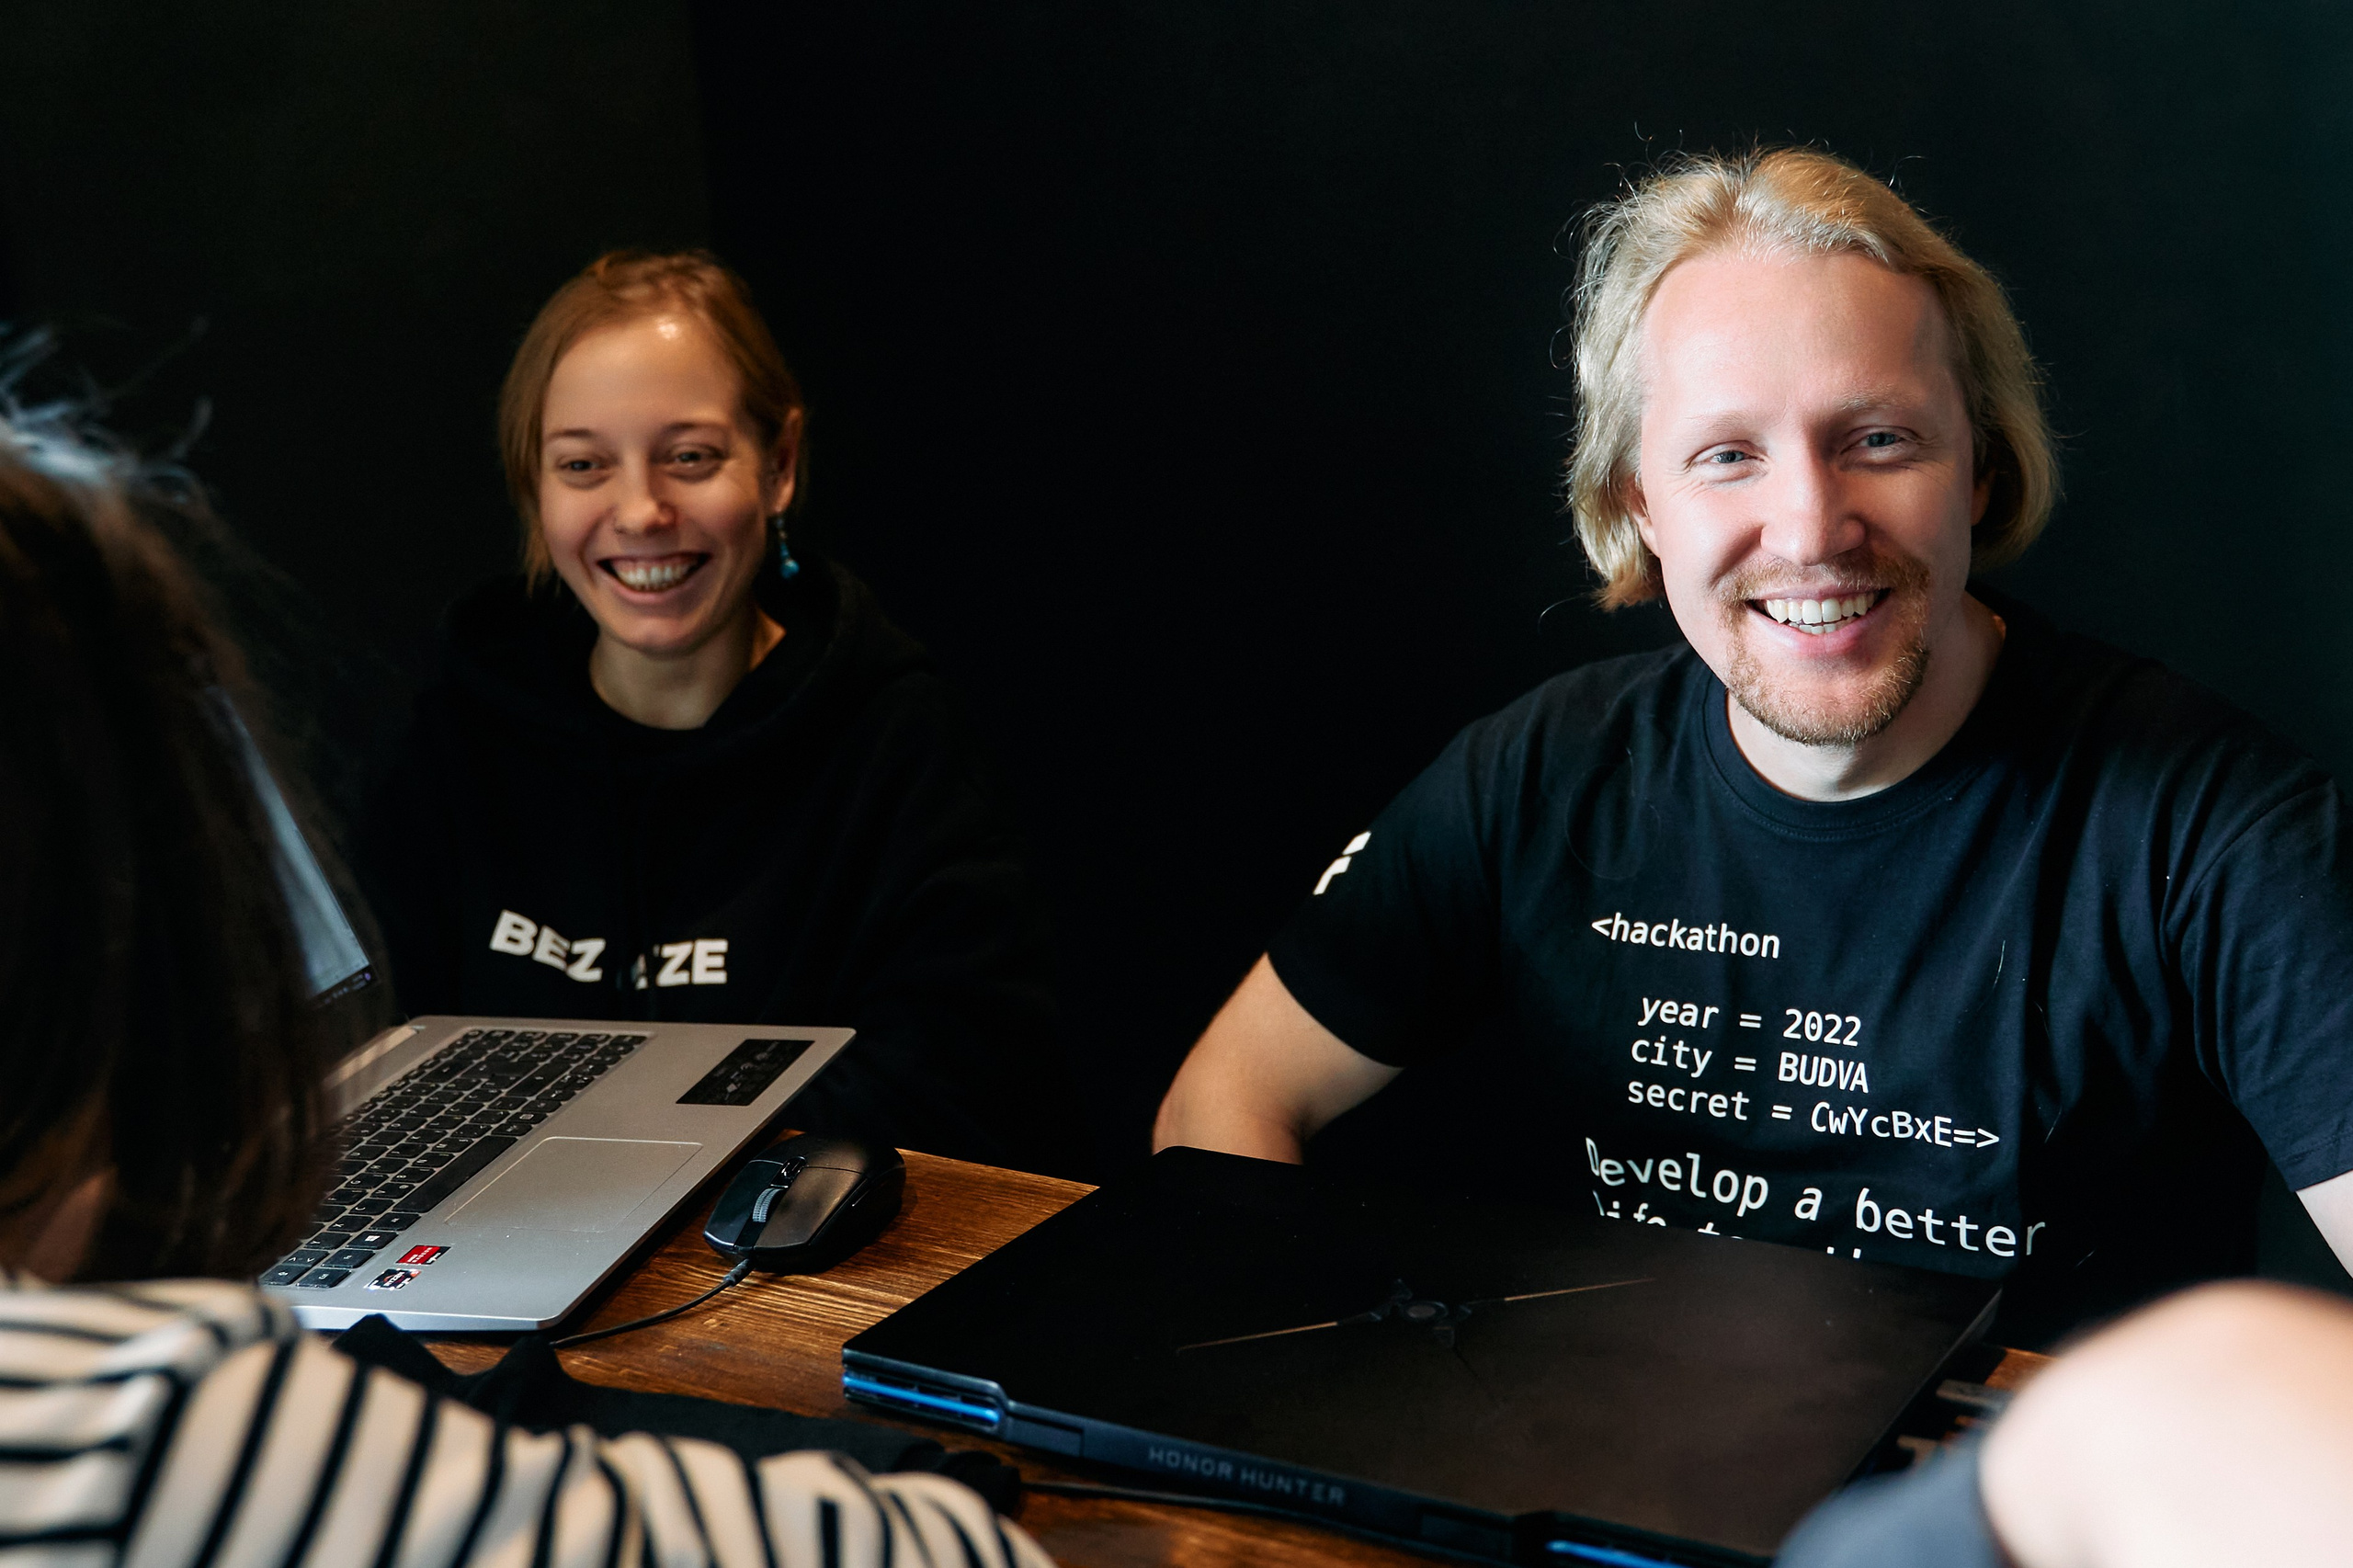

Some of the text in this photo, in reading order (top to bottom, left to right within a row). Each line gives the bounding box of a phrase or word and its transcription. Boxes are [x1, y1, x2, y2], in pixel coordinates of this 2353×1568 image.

[1592, 912, 1780, 960] <hackathon
[1638, 996, 1862, 1047] year = 2022
[1631, 1036, 1869, 1094] city = BUDVA
[1628, 1081, 2000, 1148] secret = CwYcBxE=>
[1586, 1137, 1769, 1218] Develop
[1794, 1187, 1823, 1221] a
[1856, 1187, 2047, 1257] better
[1149, 1447, 1346, 1507] HONOR HUNTER
